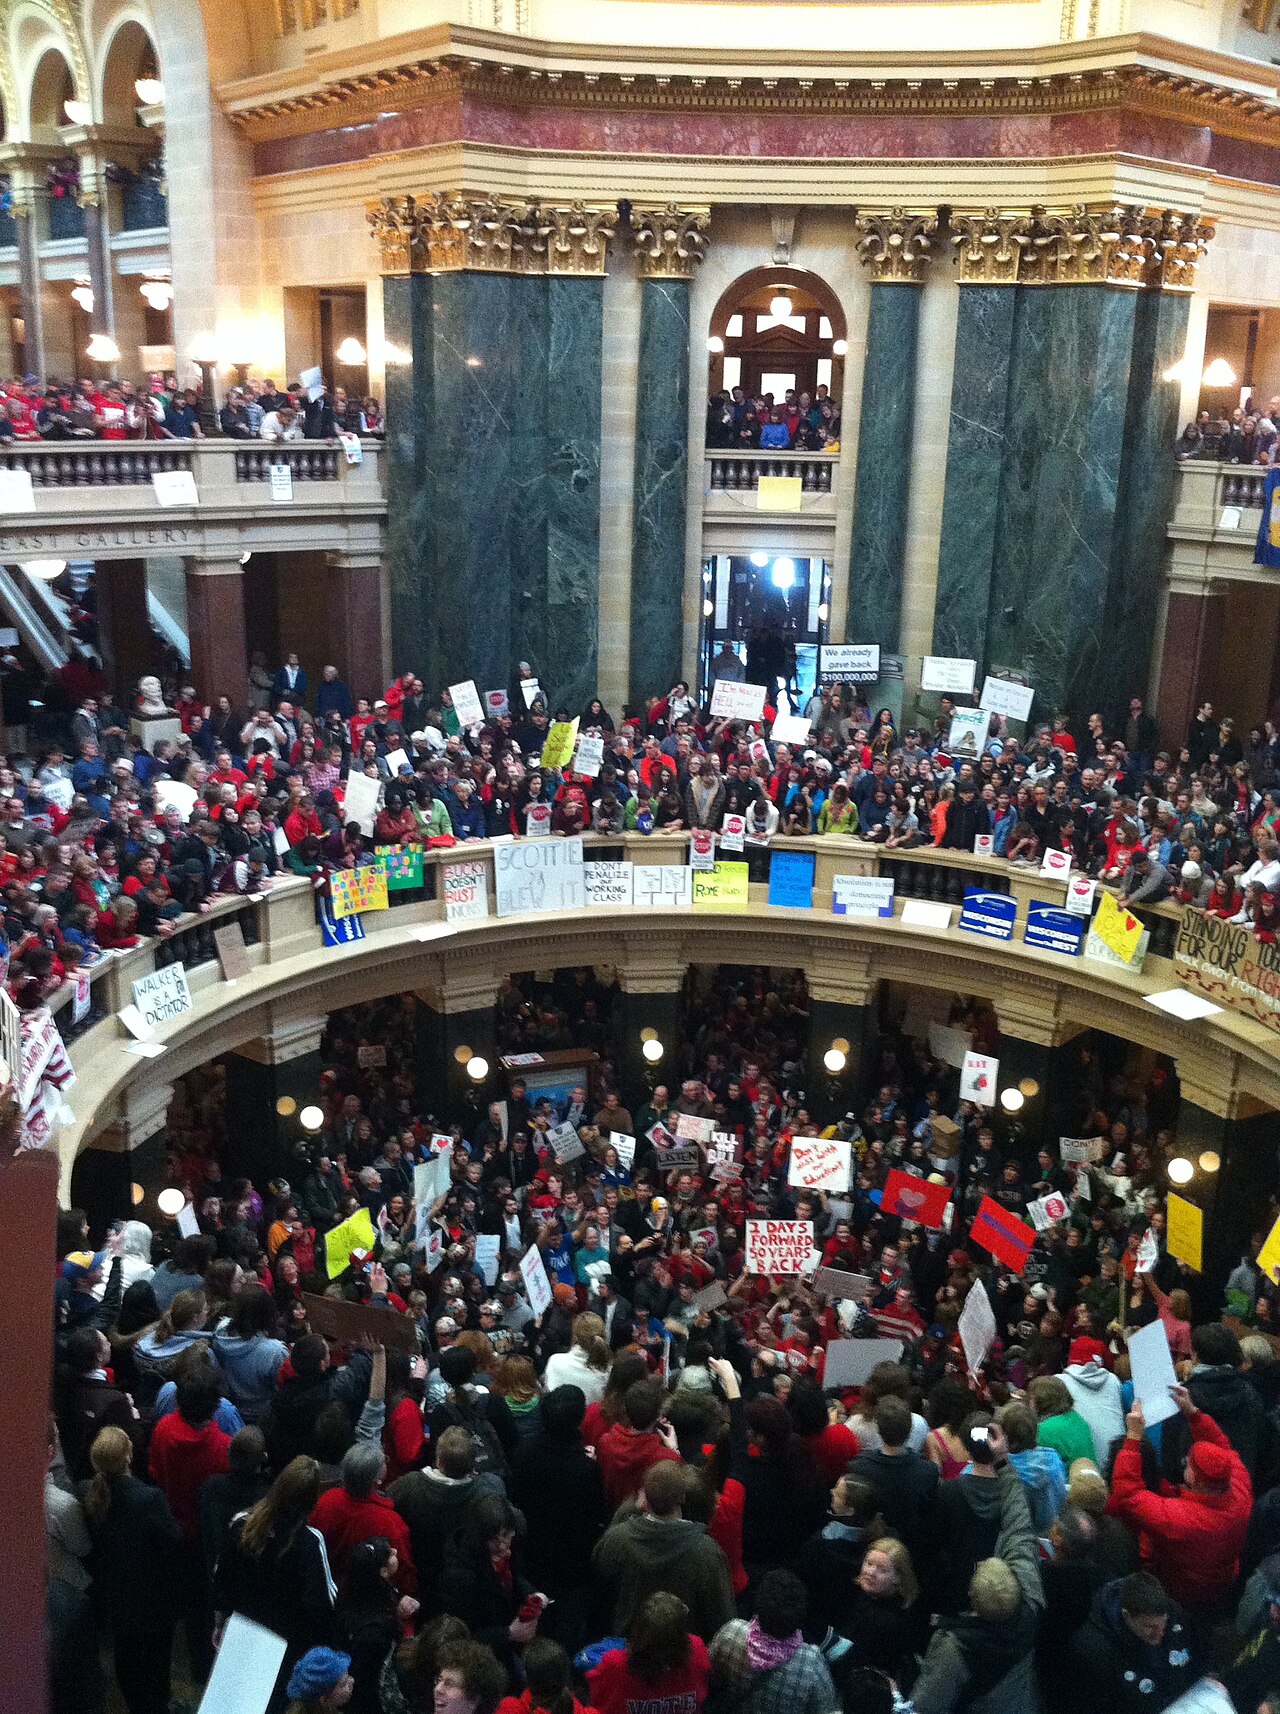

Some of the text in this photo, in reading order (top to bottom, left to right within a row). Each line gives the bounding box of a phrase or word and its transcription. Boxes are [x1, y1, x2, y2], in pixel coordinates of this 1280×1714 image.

[77, 529, 189, 547] GALLERY
[824, 648, 872, 658] We already
[827, 661, 872, 670] gave back
[821, 672, 879, 681] $100,000,000
[499, 840, 583, 871] SCOTTIE
[444, 862, 485, 878] BUCKY
[584, 871, 629, 879] PENALIZE
[444, 887, 477, 905] BUST
[560, 880, 580, 907] IT
[585, 885, 627, 894] WORKING
[593, 894, 622, 902] CLASS
[1178, 931, 1206, 960] FOR
[1209, 945, 1238, 977] OUR
[135, 966, 181, 997] WALKER
[145, 995, 189, 1025] DICTATOR
[659, 1151, 698, 1162] LISTEN
[766, 1221, 808, 1234] DAYS
[751, 1235, 815, 1247] FORWARD
[749, 1247, 811, 1260] 50 YEARS
[756, 1259, 804, 1273] BACK
